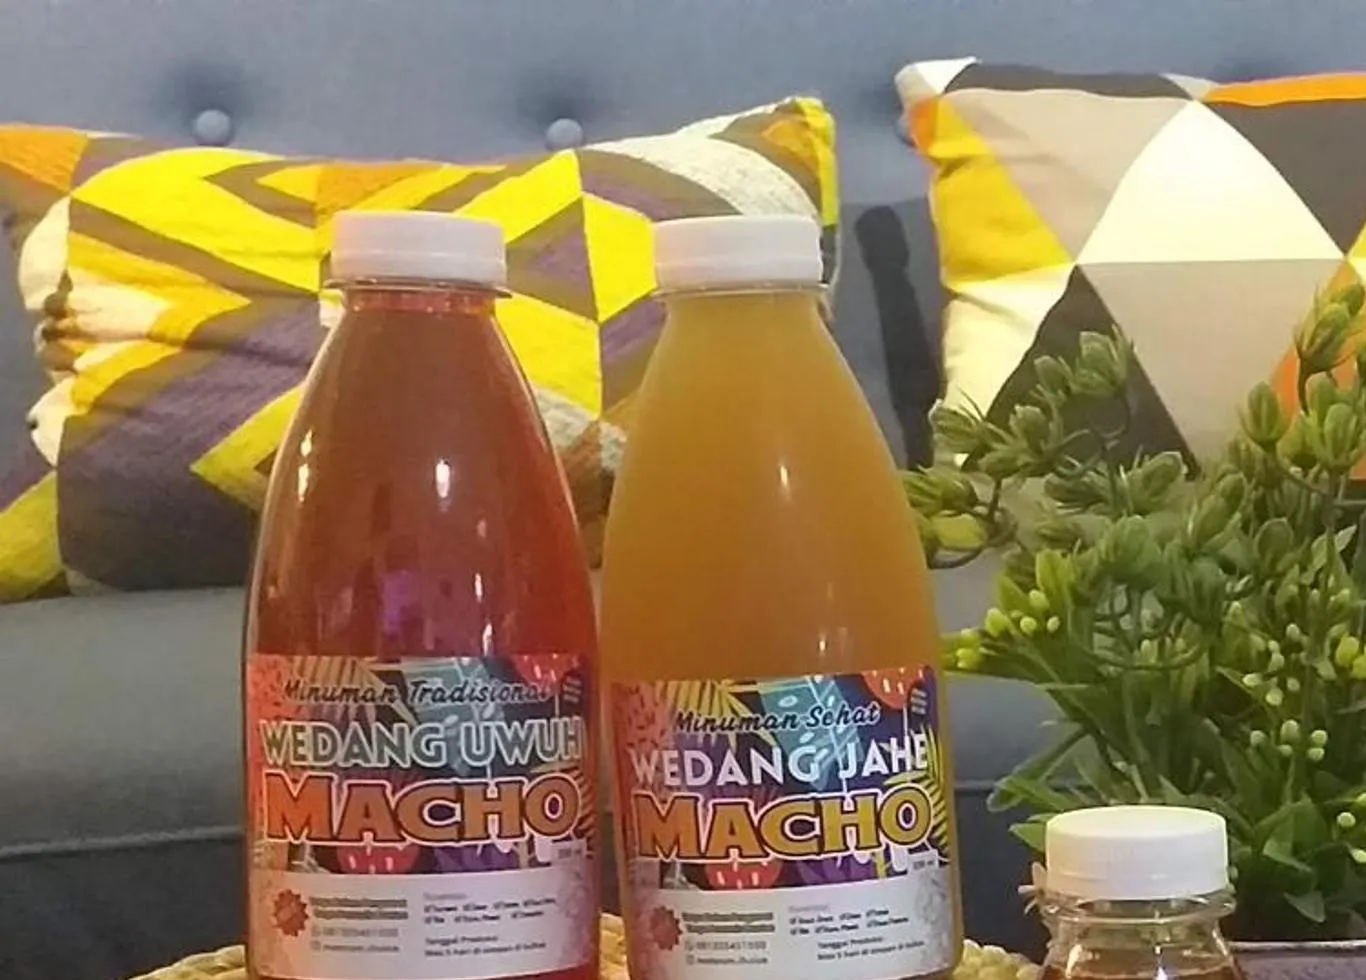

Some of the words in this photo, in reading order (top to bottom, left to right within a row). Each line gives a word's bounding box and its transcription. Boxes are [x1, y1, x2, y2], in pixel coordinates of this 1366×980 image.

[284, 679, 398, 704] Minuman
[410, 679, 555, 704] Tradisional
[672, 710, 798, 734] Minuman
[805, 701, 880, 729] Sehat
[261, 719, 447, 768] WEDANG
[460, 716, 584, 766] UWUH
[629, 745, 819, 787] WEDANG
[838, 732, 928, 778] JAHE
[264, 769, 582, 846] MACHO
[633, 784, 933, 862] MACHO
